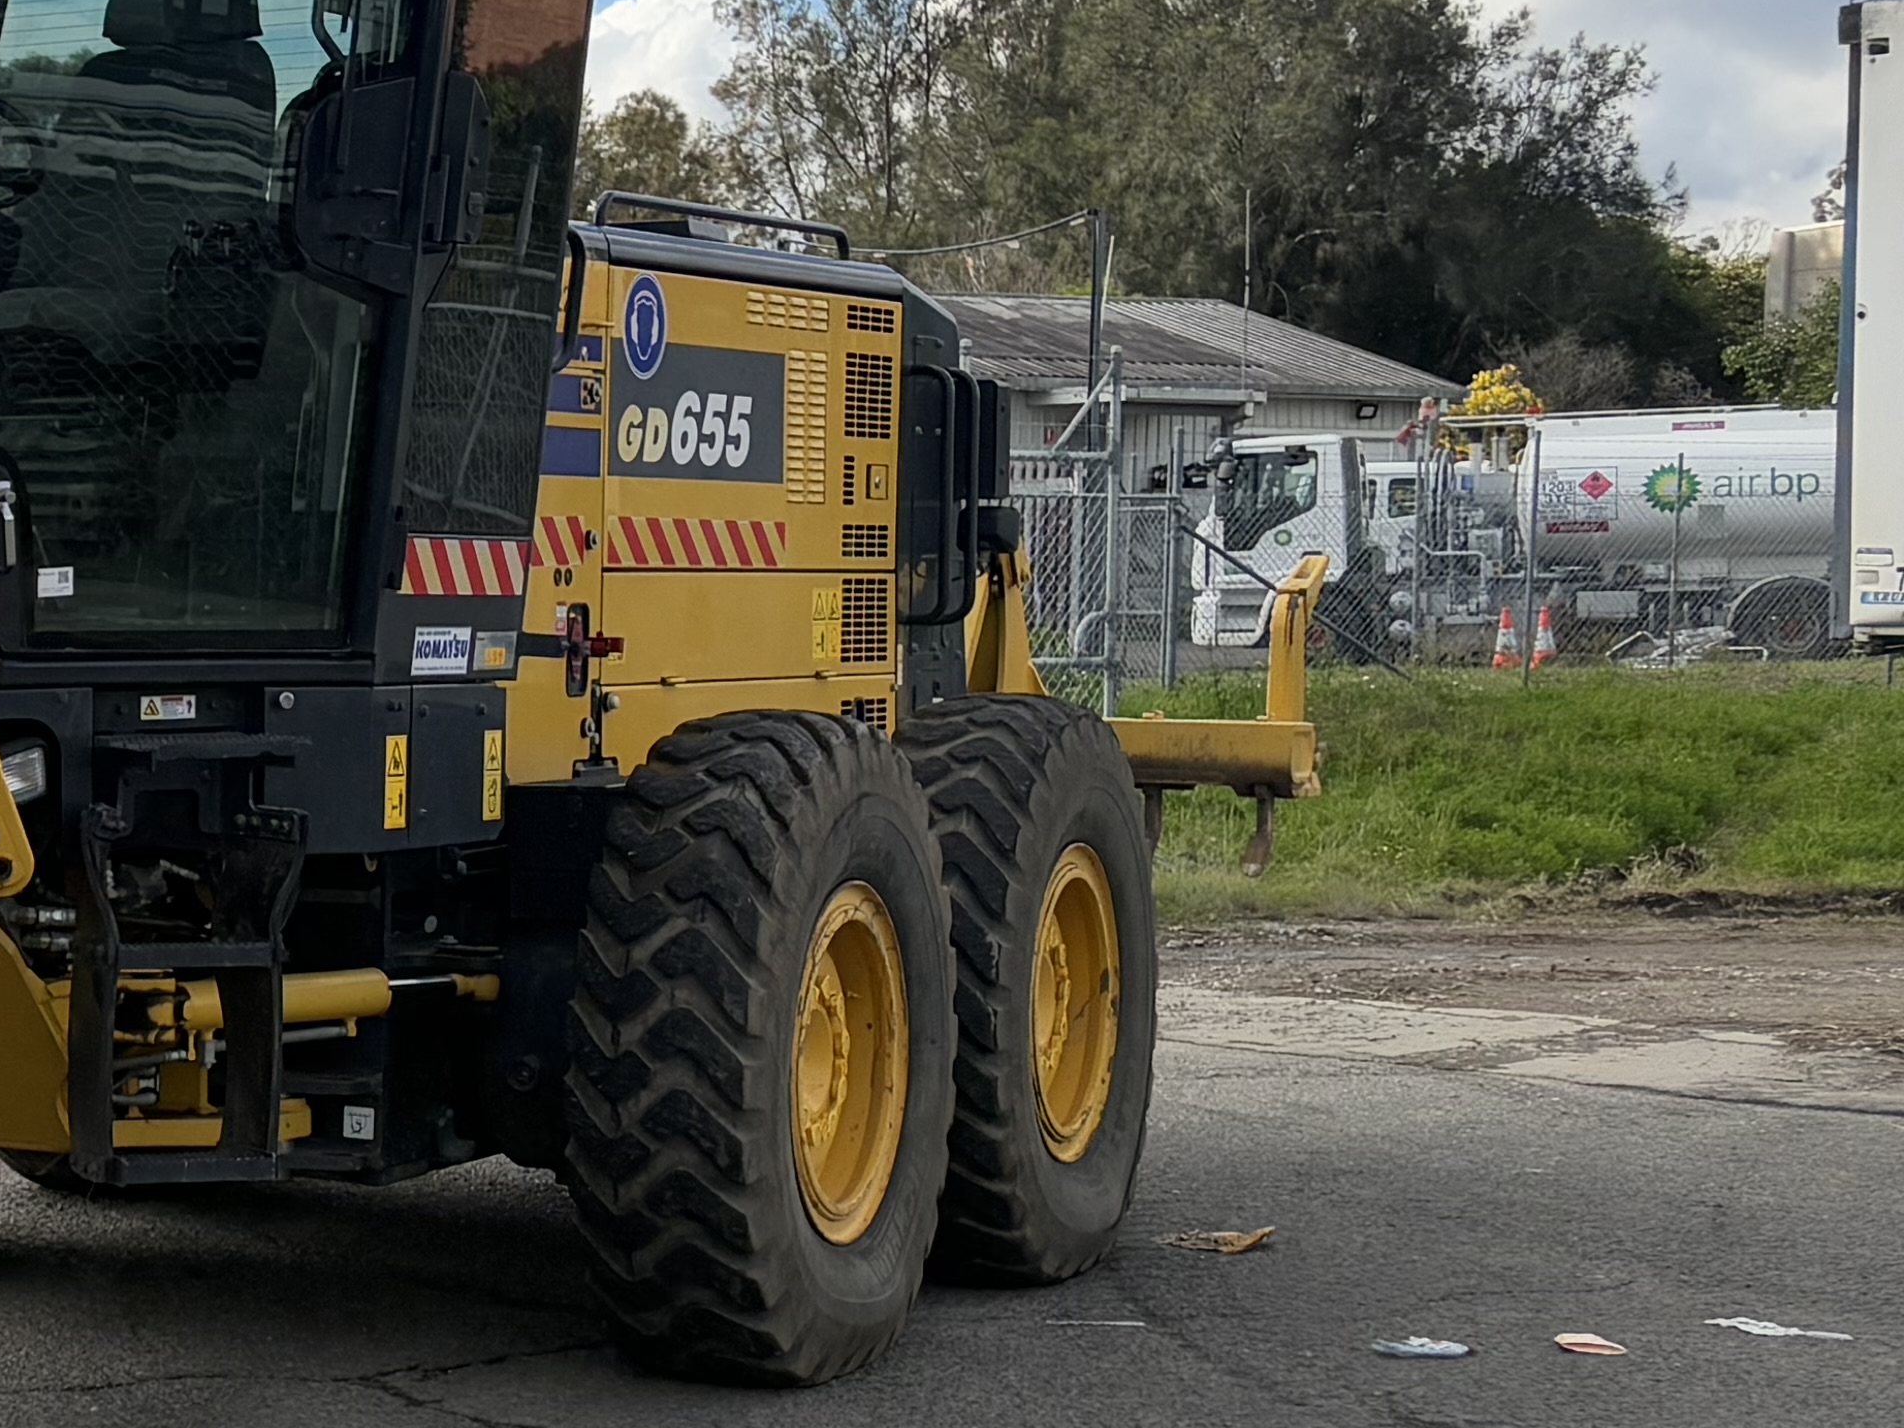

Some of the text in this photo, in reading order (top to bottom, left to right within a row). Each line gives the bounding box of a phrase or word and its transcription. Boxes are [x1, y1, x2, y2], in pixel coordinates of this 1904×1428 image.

[617, 390, 753, 468] GD655
[1713, 466, 1820, 502] air bp
[415, 633, 469, 660] KOMATSU
